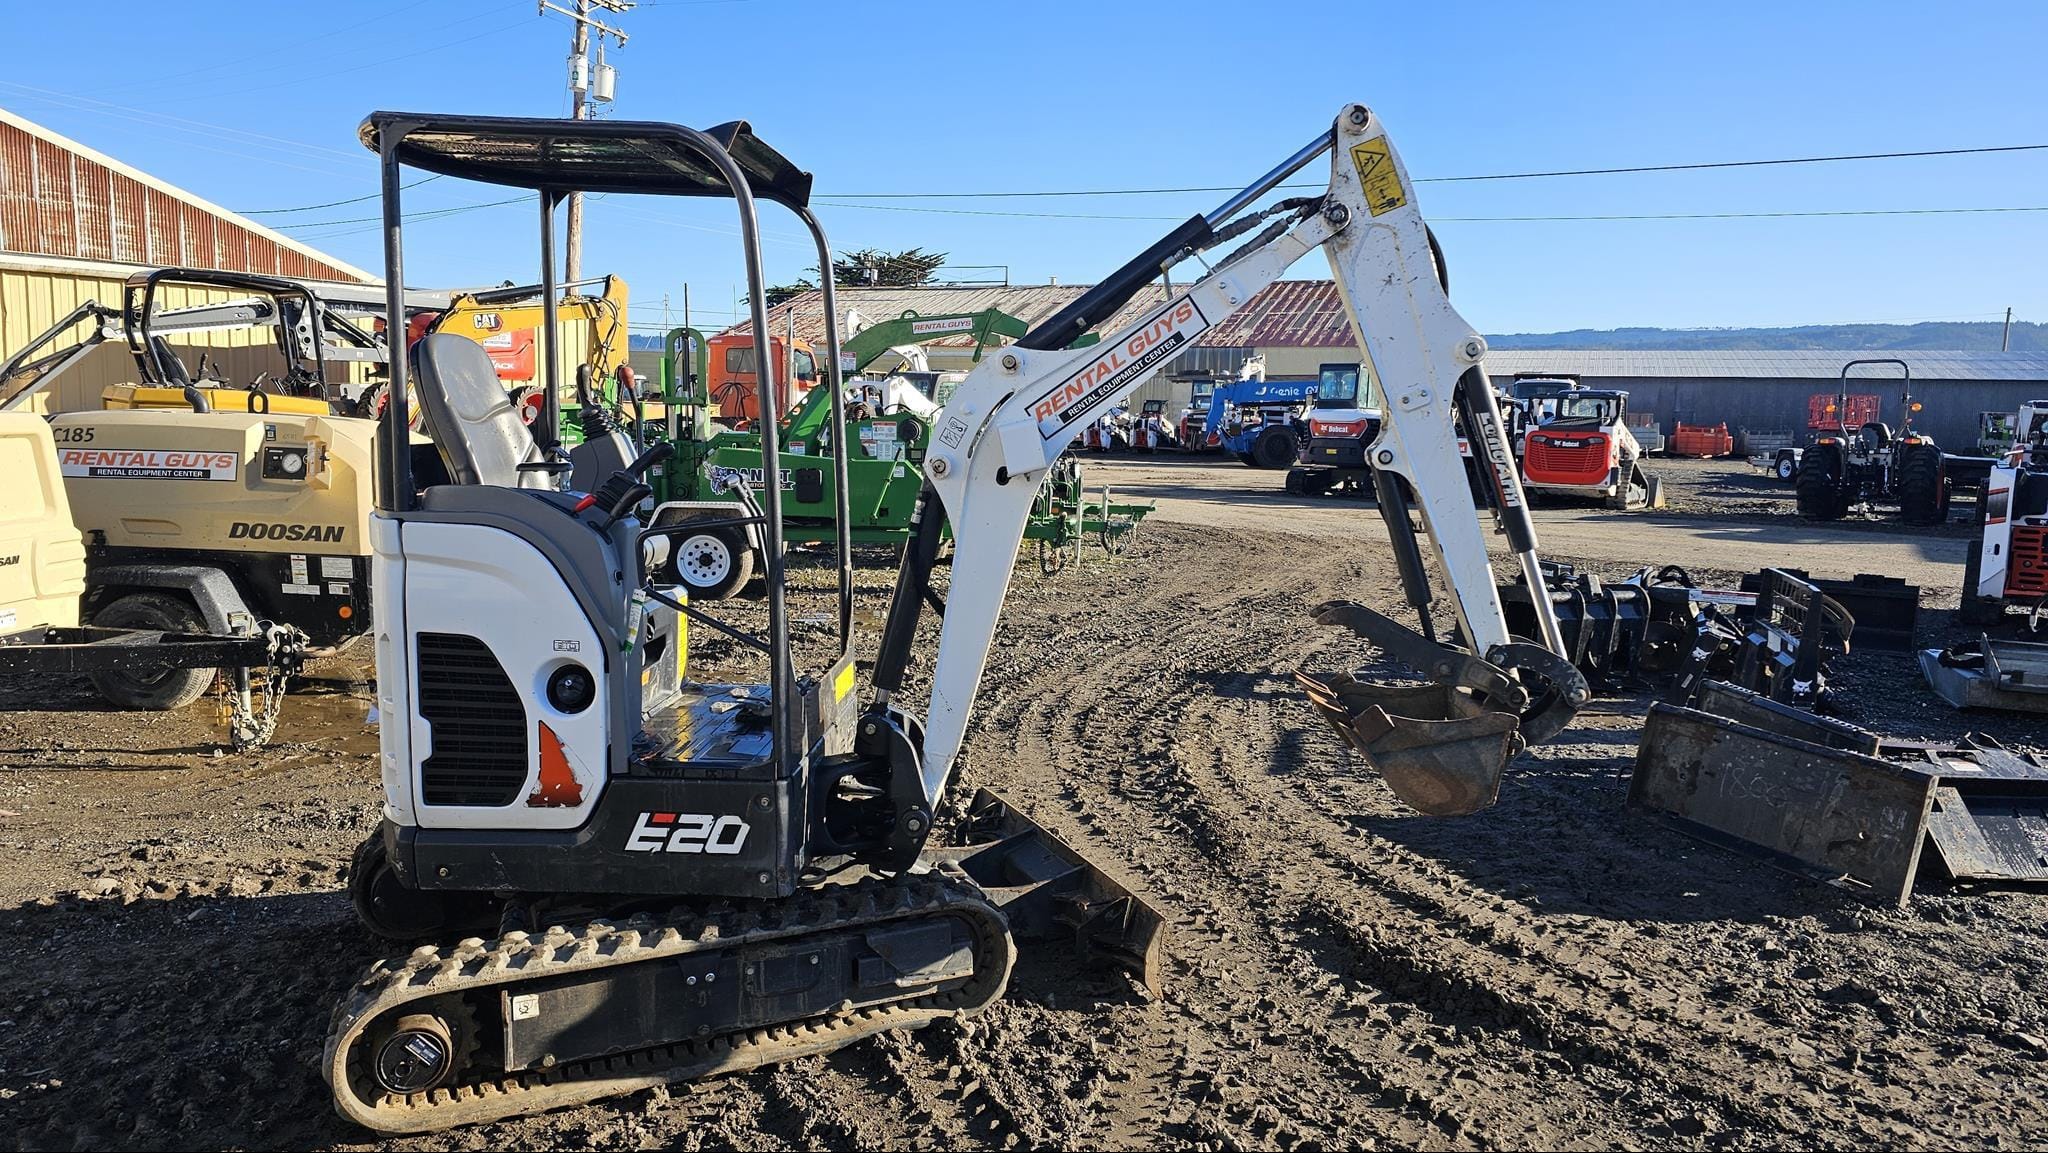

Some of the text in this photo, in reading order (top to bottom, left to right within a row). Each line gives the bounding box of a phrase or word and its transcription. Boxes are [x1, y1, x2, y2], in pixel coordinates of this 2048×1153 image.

[473, 313, 496, 329] CAT
[914, 320, 971, 331] RENTAL GUYS
[1035, 303, 1193, 423] RENTAL GUYS
[1067, 338, 1177, 417] RENTAL EQUIPMENT CENTER
[63, 451, 234, 469] RENTAL GUYS
[97, 468, 203, 478] RENTAL EQUIPMENT CENTER
[229, 522, 345, 542] DOOSAN
[624, 812, 752, 855] E20
